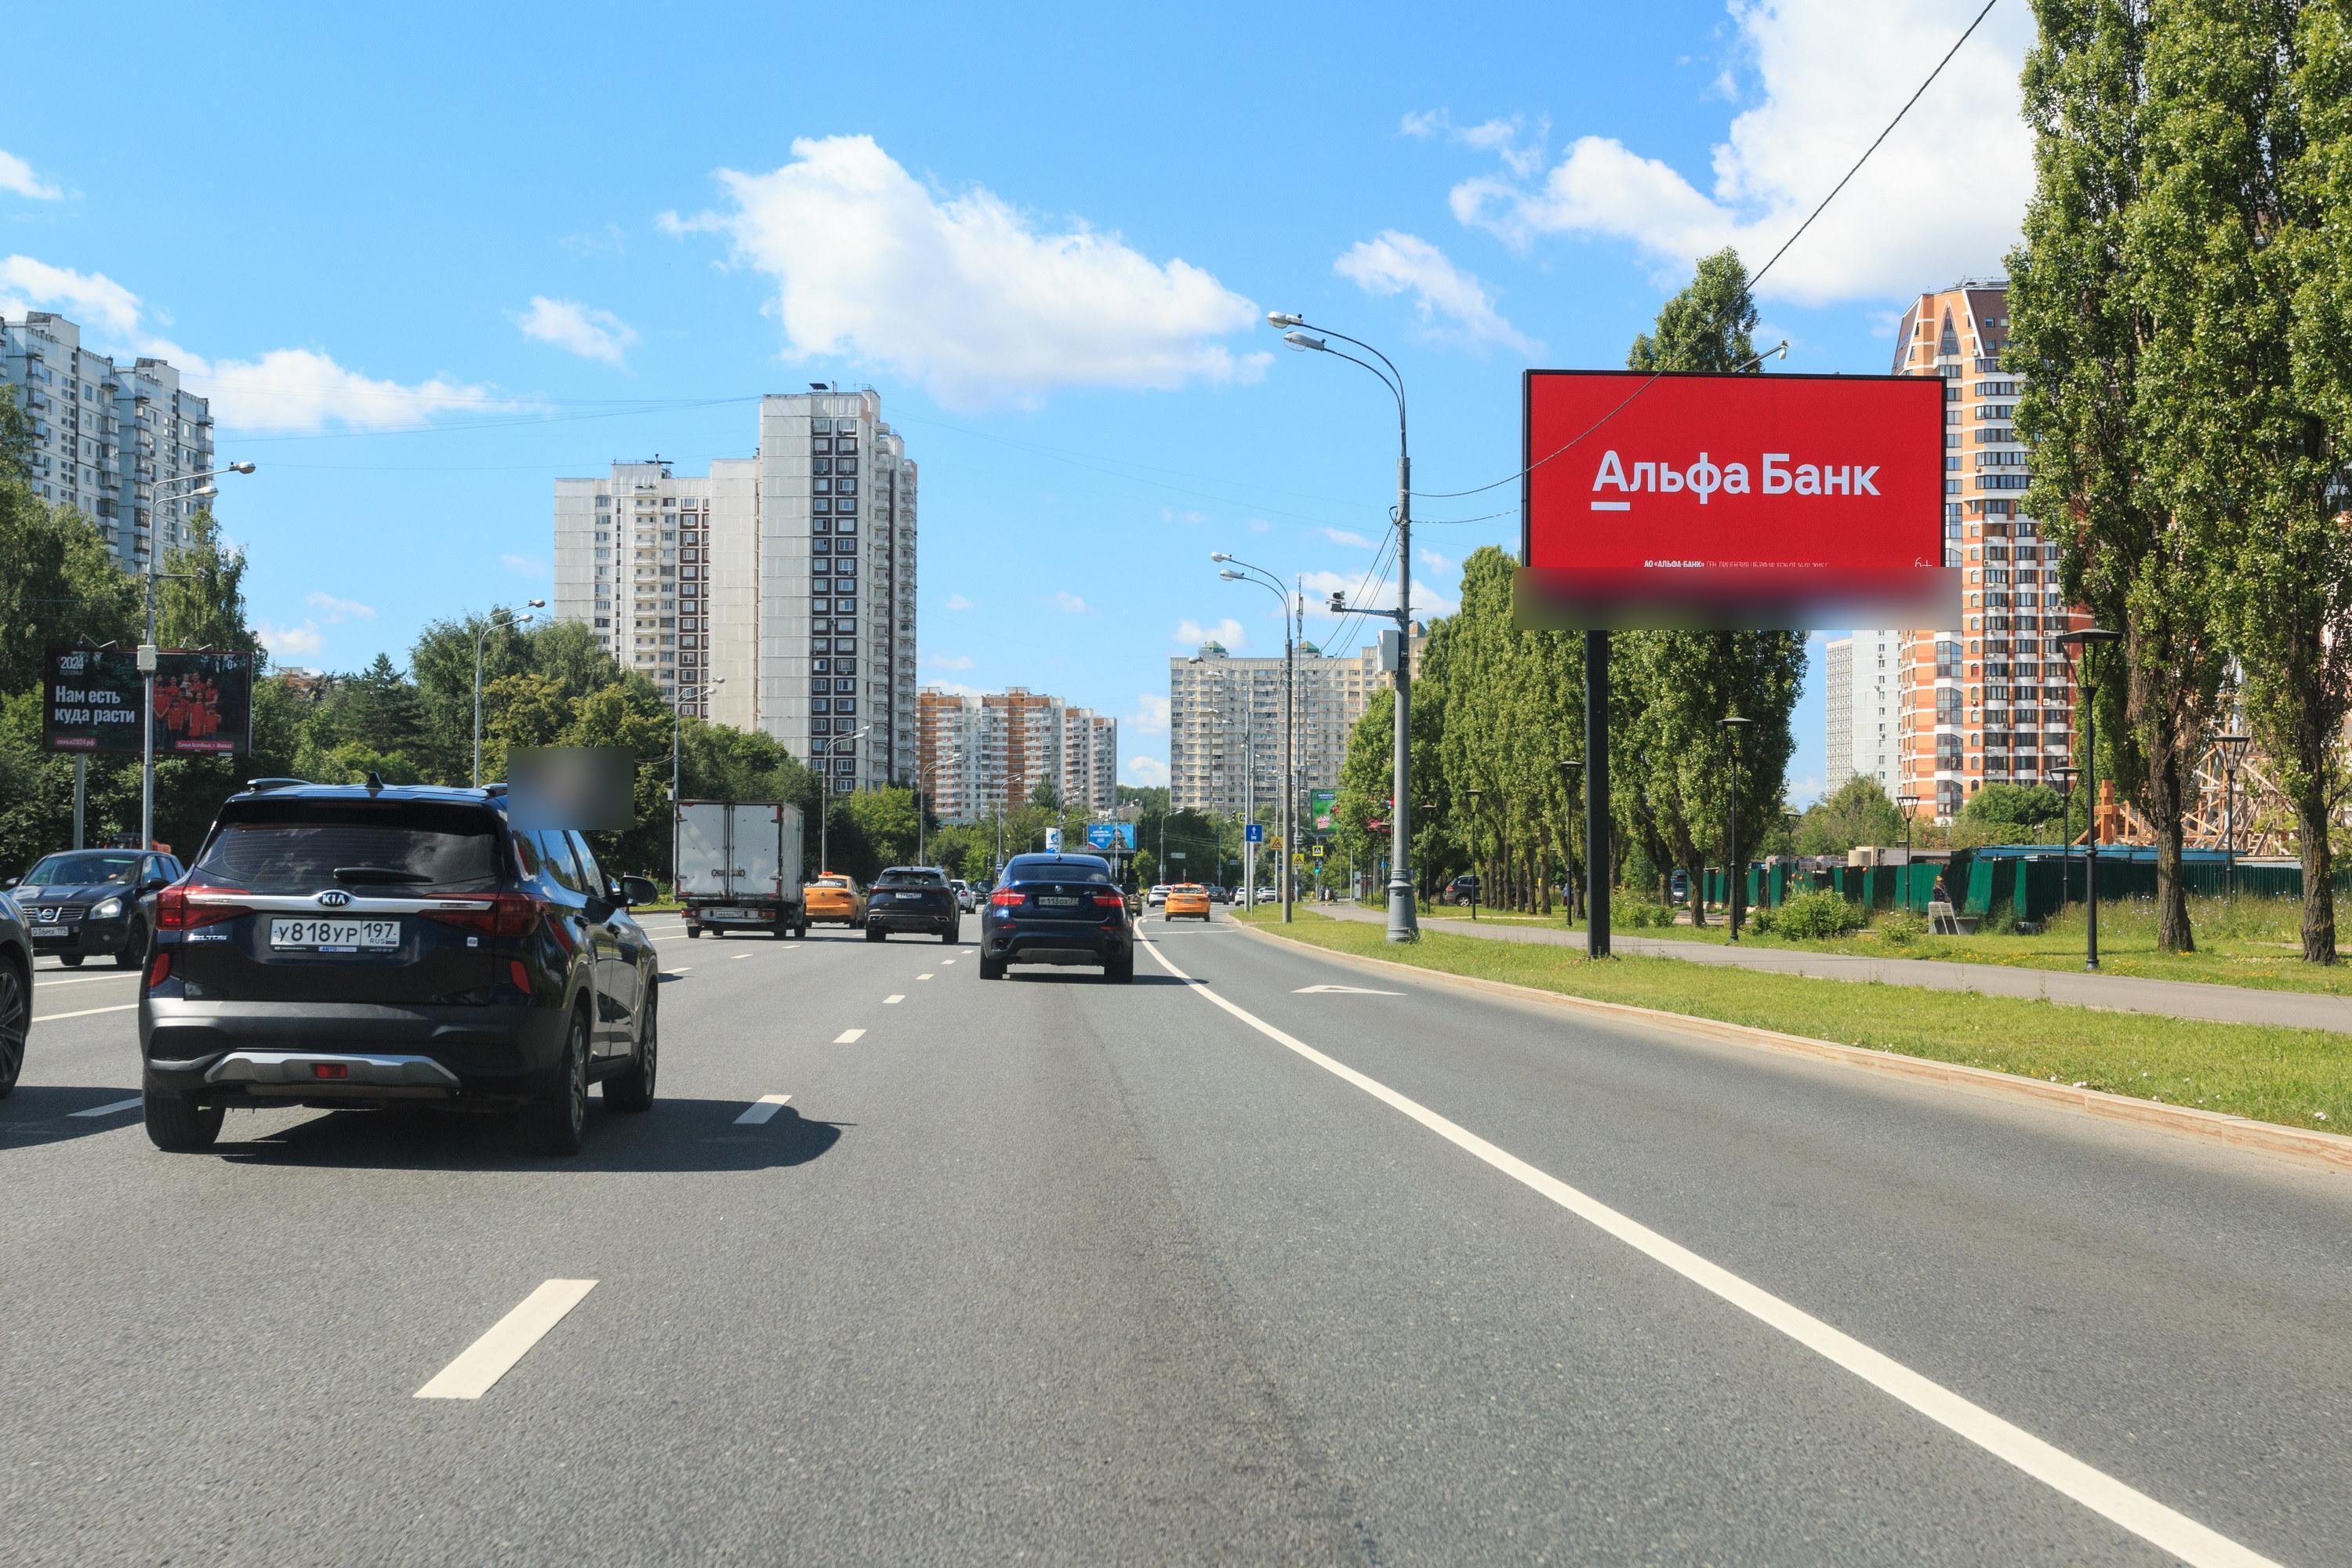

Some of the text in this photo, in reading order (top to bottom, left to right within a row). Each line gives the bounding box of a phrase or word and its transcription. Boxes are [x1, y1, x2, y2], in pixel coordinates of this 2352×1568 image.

[1592, 450, 1881, 505] Альфа Банк
[60, 656, 84, 670] 2024
[56, 685, 121, 704] Нам есть
[55, 708, 135, 725] куда расти
[322, 895, 346, 905] KIA
[278, 922, 394, 942] У818УР 197
